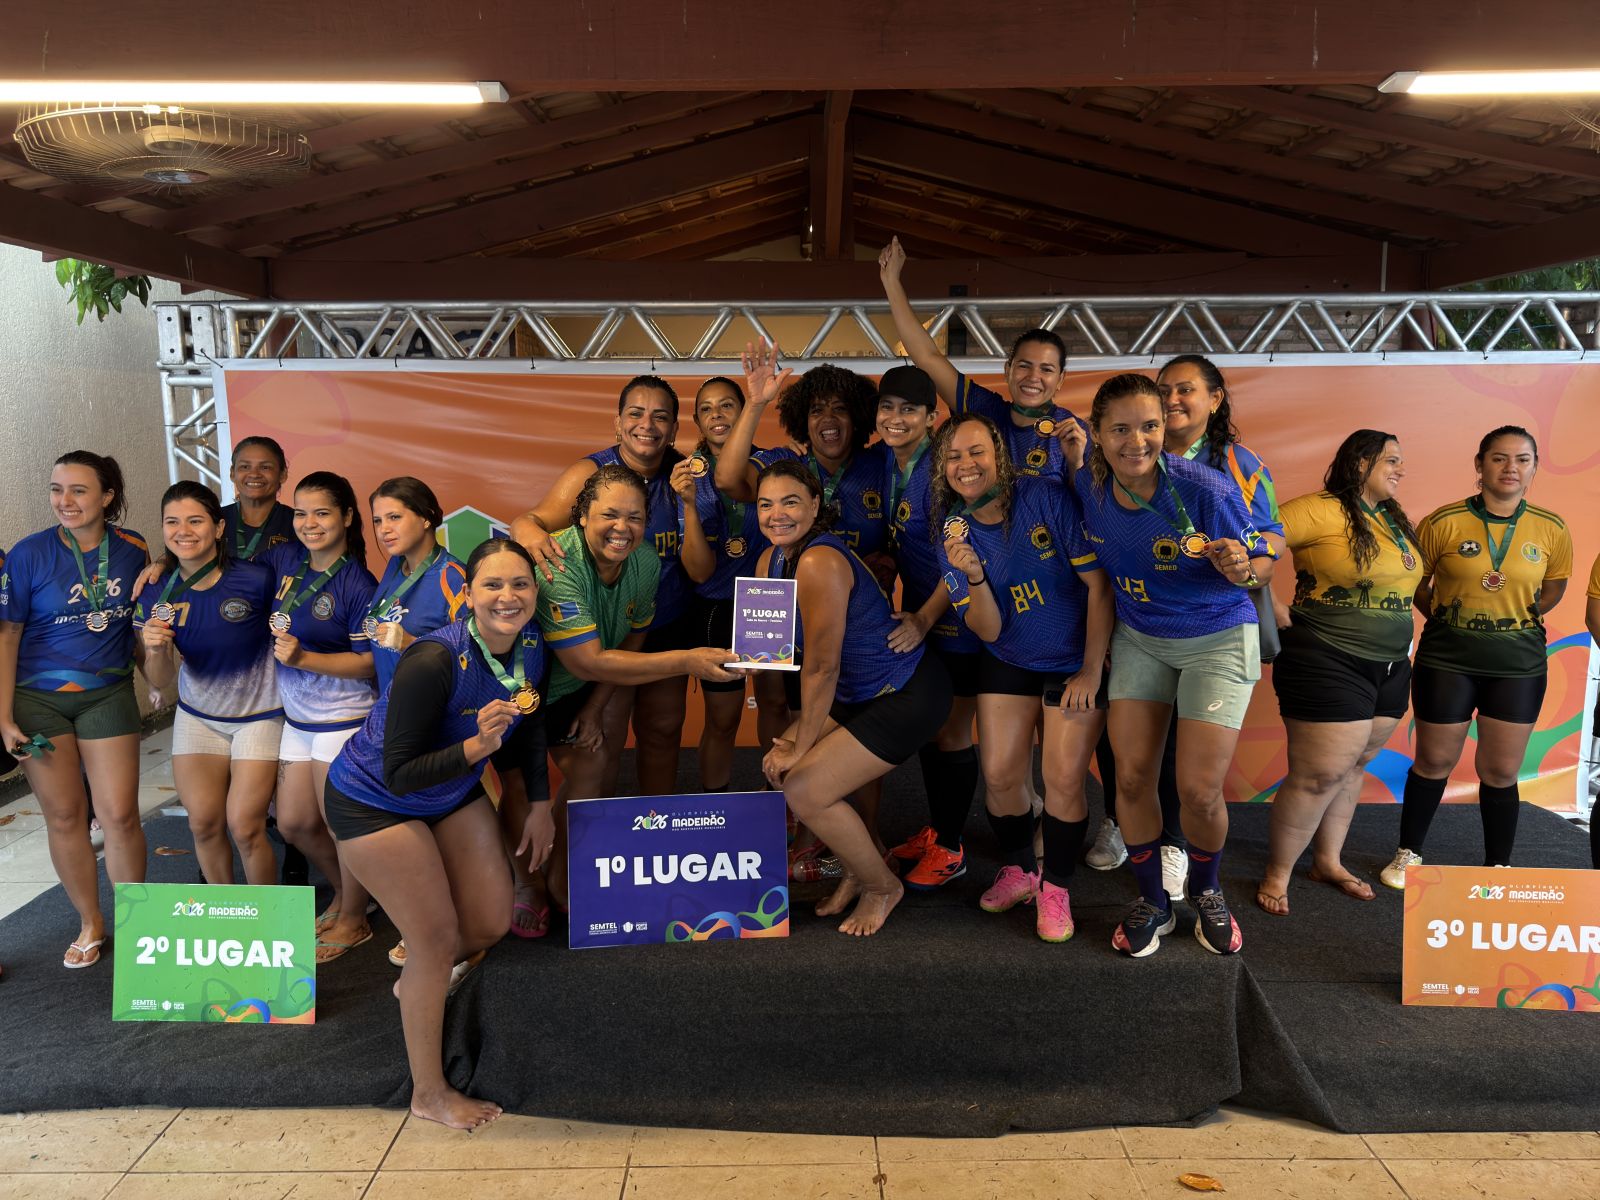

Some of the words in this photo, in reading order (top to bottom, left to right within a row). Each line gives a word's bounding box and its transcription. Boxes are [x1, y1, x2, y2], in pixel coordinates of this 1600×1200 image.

[1010, 578, 1045, 614] 84
[1116, 576, 1151, 602] 43
[742, 608, 752, 617] 1º
[752, 609, 787, 619] LUGAR
[632, 813, 669, 831] 2026
[671, 814, 726, 828] MADEIRÃO
[595, 855, 626, 888] 1º
[633, 851, 762, 886] LUGAR
[1467, 884, 1507, 900] 2026
[1508, 889, 1565, 900] MADEIRÃO
[172, 900, 206, 917] 2026
[208, 905, 259, 917] MADEIRÃO
[589, 921, 618, 931] SEMTEL
[1426, 919, 1465, 949] 3º
[1472, 922, 1600, 954] LUGAR
[136, 935, 170, 965] 2º
[176, 938, 295, 968] LUGAR
